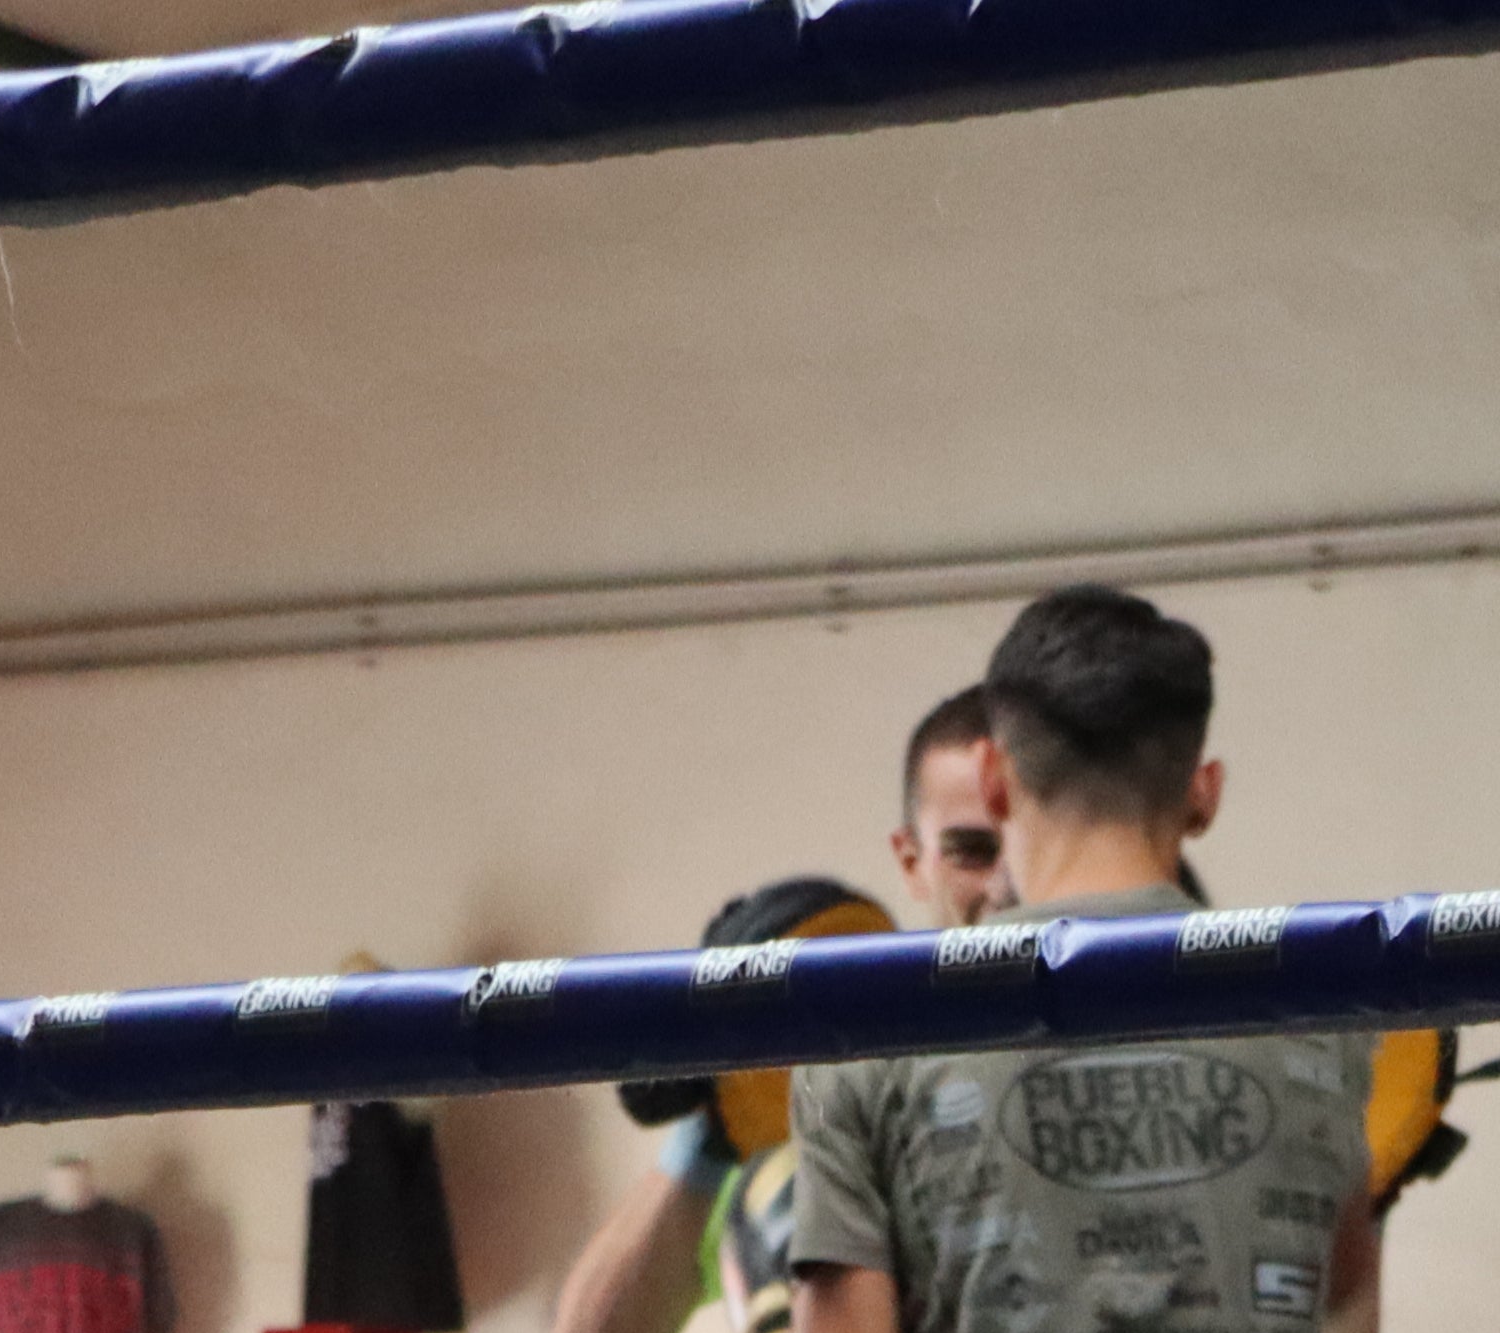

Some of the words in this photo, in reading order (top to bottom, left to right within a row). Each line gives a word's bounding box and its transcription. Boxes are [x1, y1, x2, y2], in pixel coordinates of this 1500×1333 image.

[941, 937, 1033, 966] BOXING
[1184, 923, 1278, 951] BOXING
[1023, 1057, 1244, 1114] PUEBLO
[1031, 1106, 1251, 1176] BOXING
